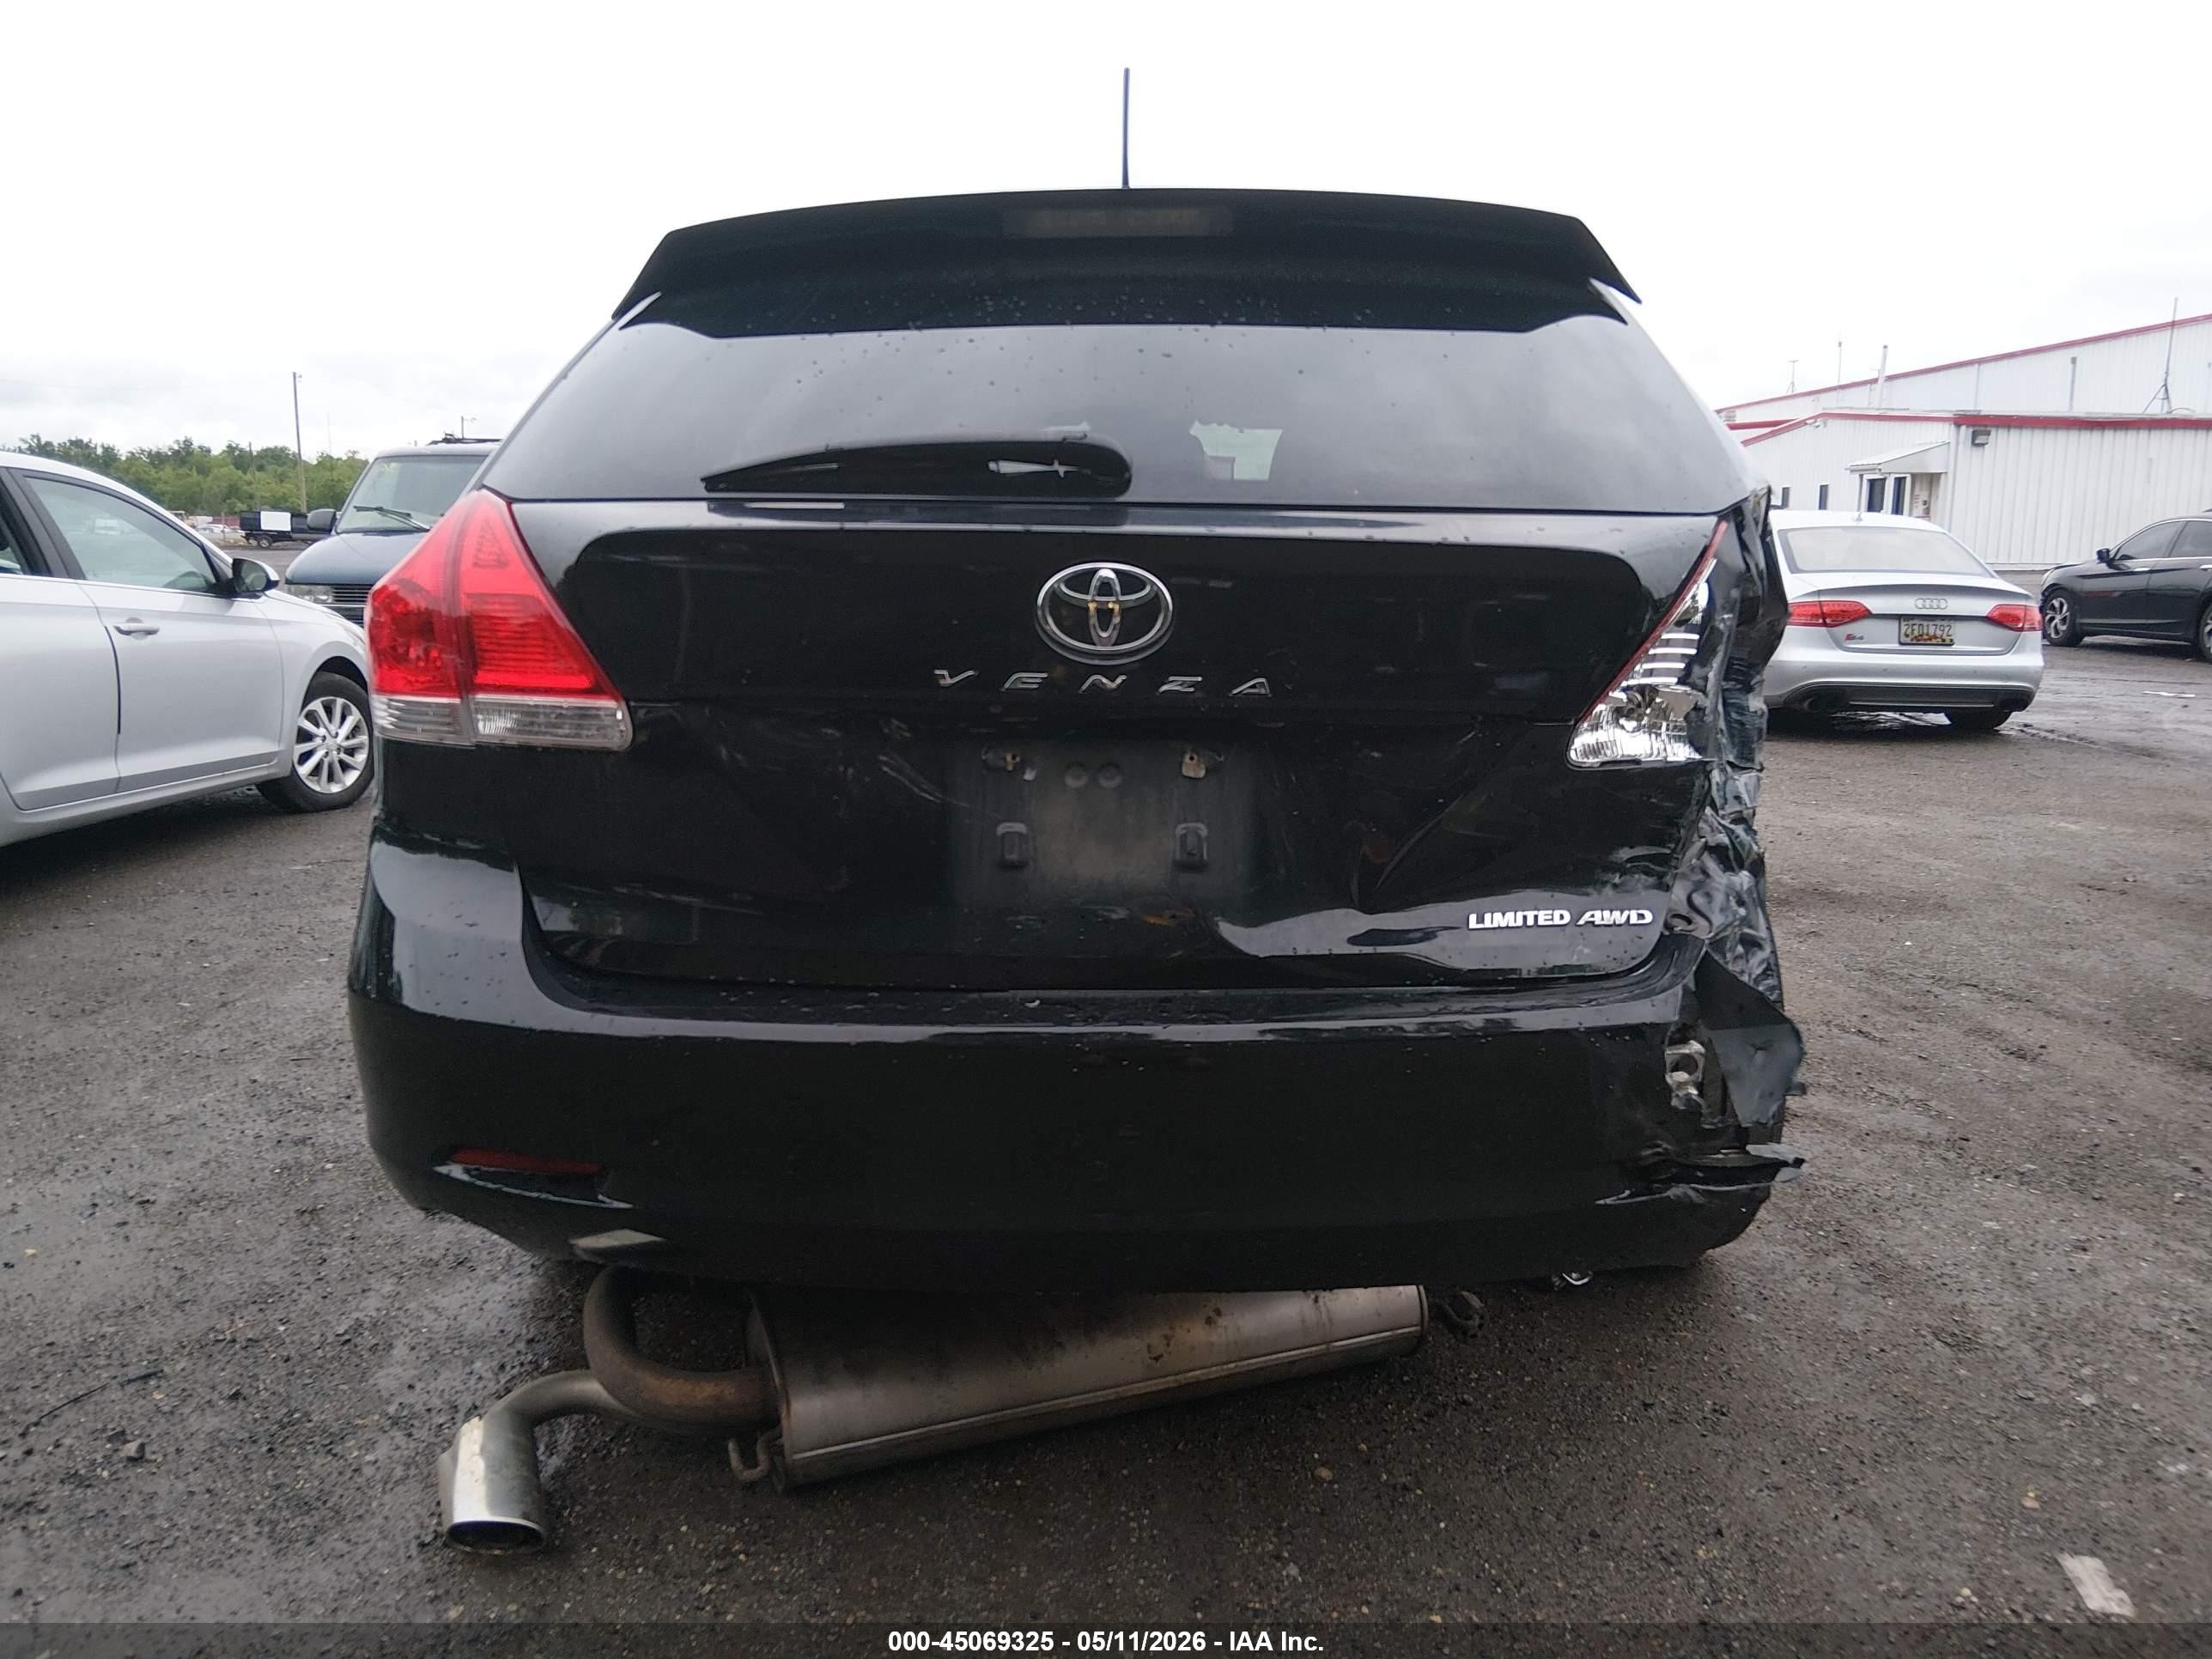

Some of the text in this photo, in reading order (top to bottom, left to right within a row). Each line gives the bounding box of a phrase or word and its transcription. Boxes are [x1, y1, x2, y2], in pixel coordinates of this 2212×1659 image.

[934, 668, 1271, 696] VENZA
[1468, 909, 1654, 930] LIMITED AWD
